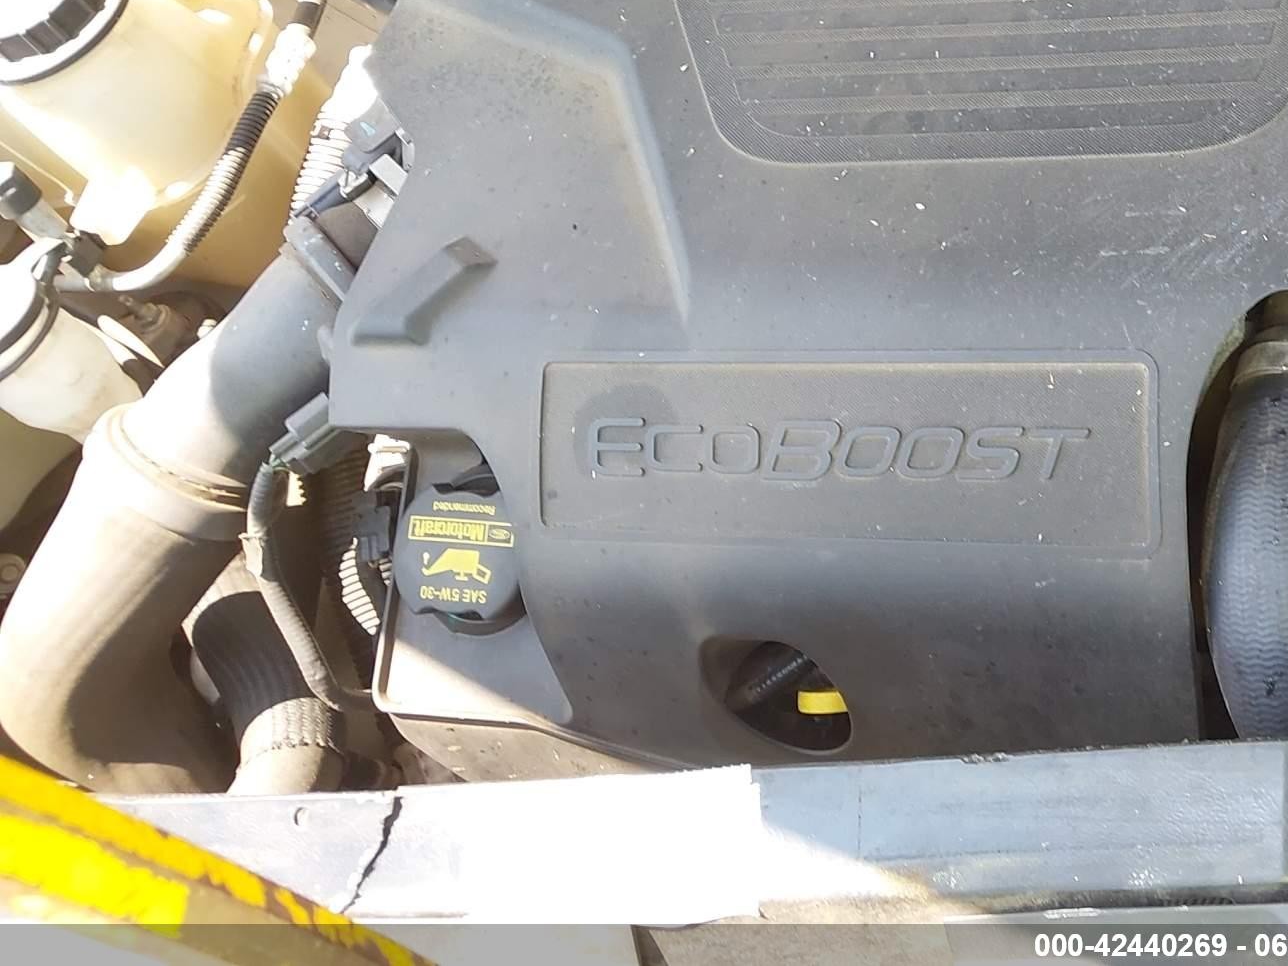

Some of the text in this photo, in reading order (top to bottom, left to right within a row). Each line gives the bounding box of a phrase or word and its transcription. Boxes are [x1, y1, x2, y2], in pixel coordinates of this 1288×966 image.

[432, 500, 496, 516] Recommended
[412, 519, 485, 541] Motorcraft
[419, 585, 488, 604] SAE 5W-30
